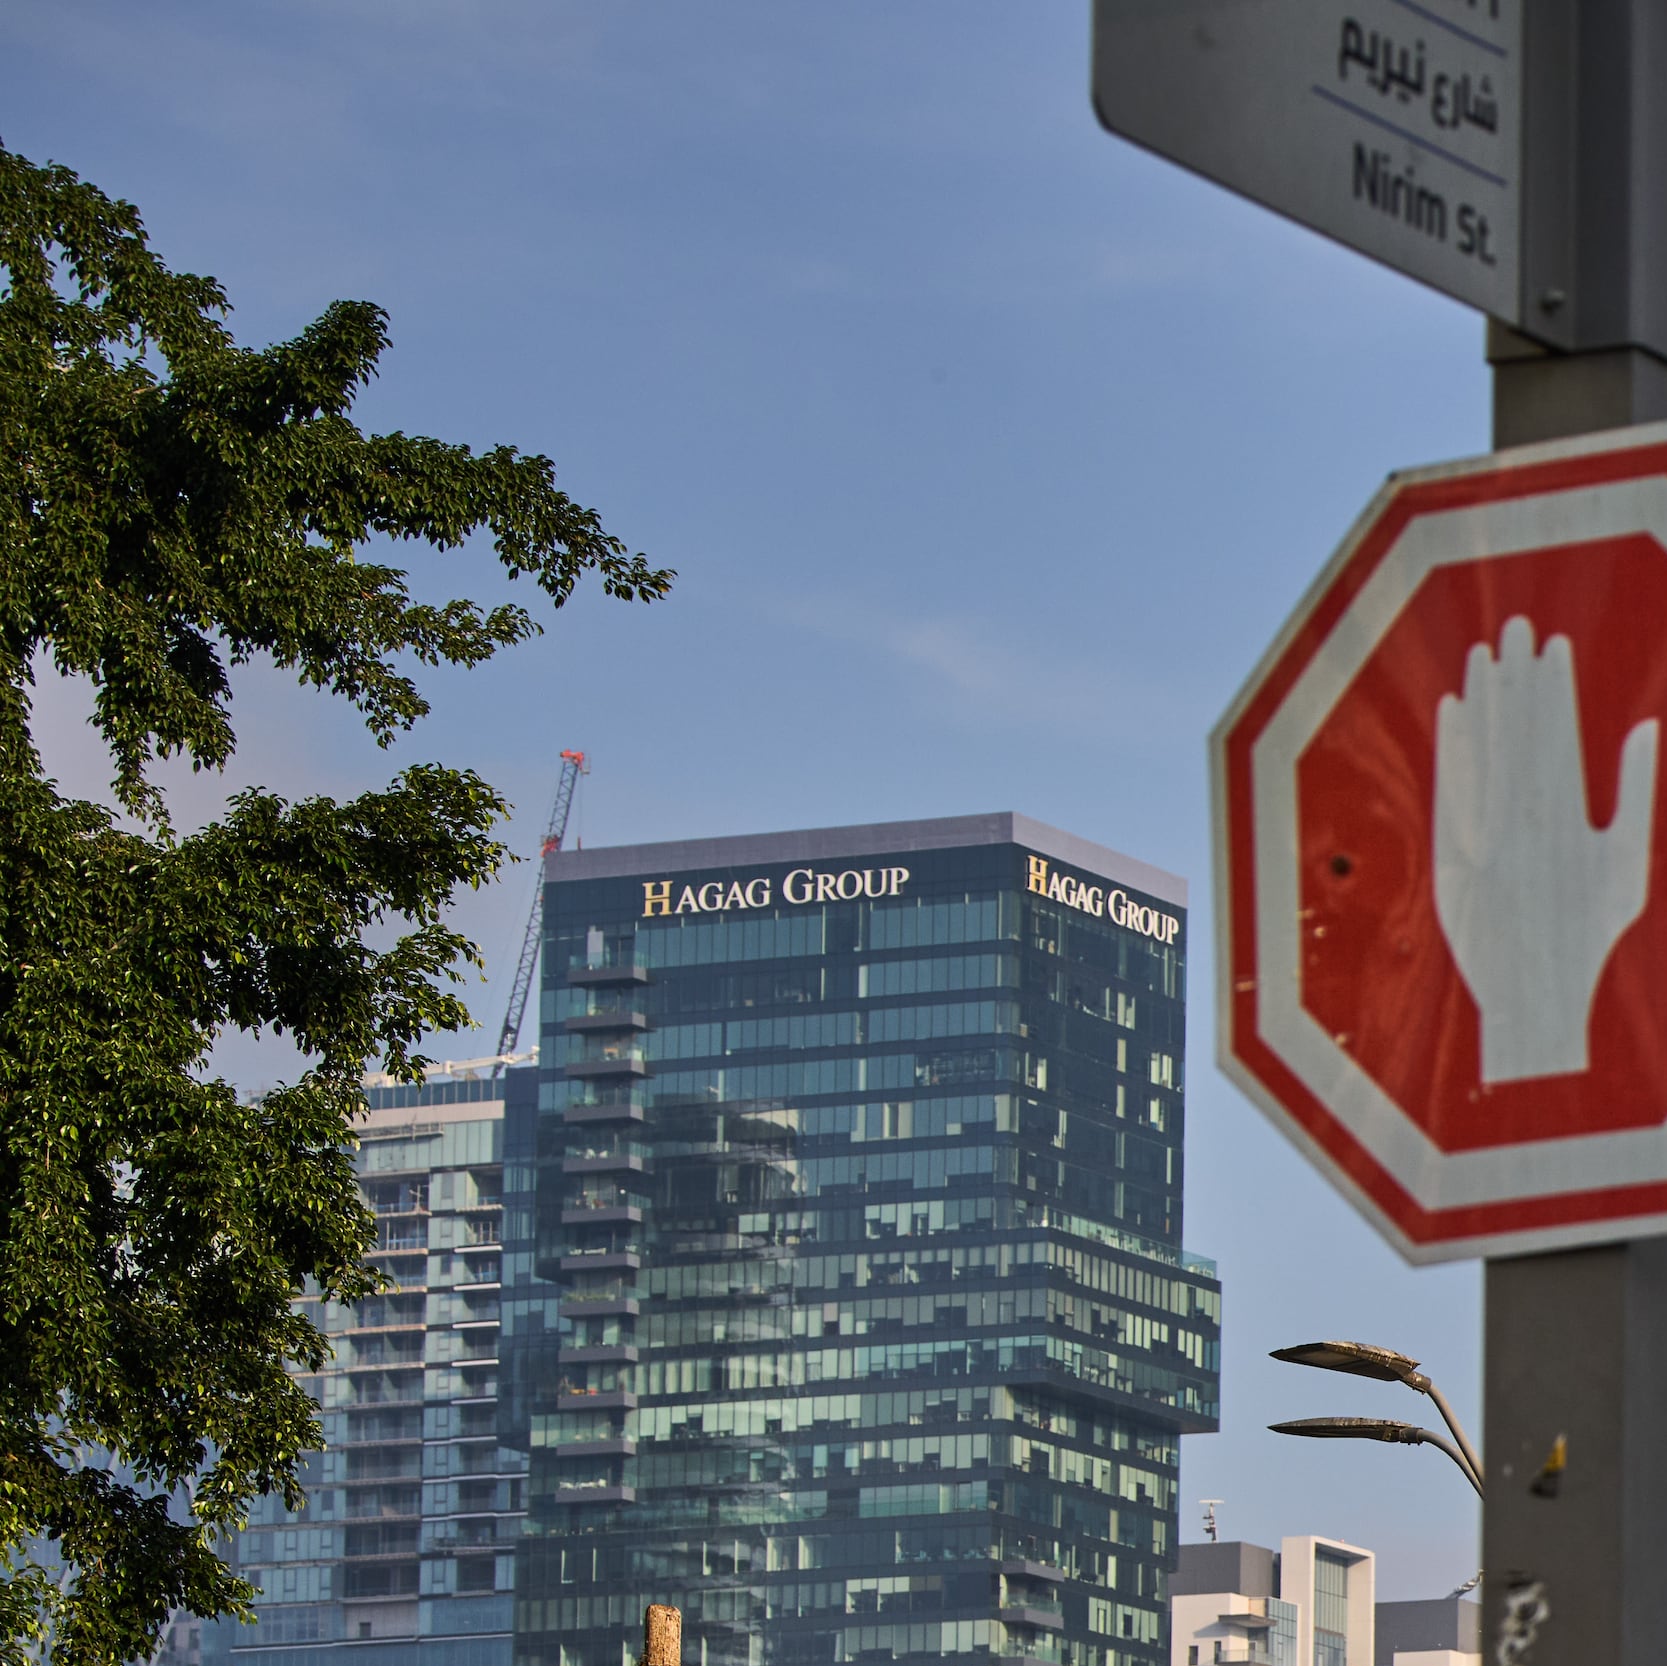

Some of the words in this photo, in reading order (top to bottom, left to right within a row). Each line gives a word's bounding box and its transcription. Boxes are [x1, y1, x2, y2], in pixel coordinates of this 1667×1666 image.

[1338, 16, 1427, 105] نيريم
[1431, 68, 1498, 135] شارع
[1352, 141, 1446, 243] Nirim
[1456, 204, 1497, 267] St.
[642, 877, 772, 918] HAGAG
[782, 866, 910, 906] GROUP
[1026, 853, 1104, 918] HAGAG
[1107, 888, 1180, 946] GROUP
